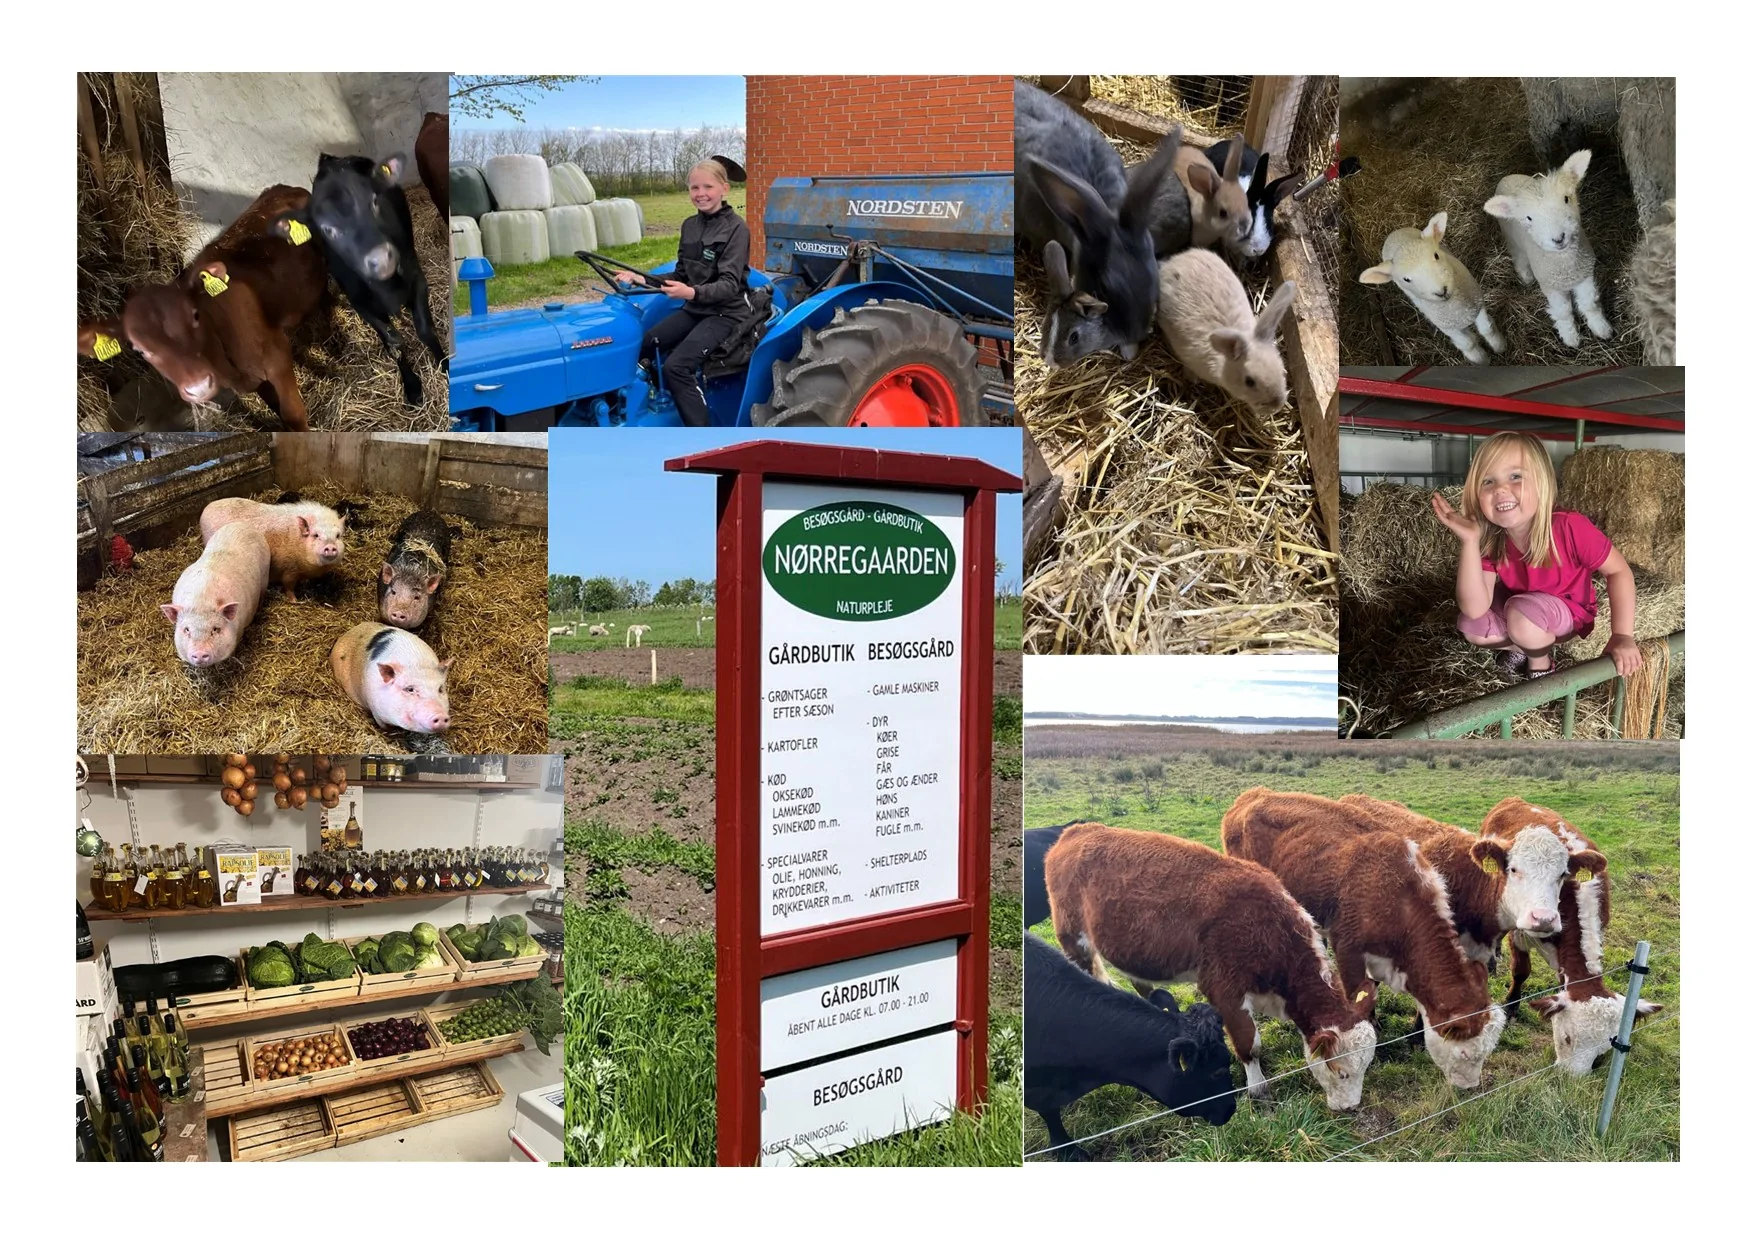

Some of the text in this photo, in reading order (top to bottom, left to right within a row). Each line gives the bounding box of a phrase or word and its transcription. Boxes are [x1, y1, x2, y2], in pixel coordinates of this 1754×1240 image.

[847, 200, 963, 219] NORDSTEN
[794, 242, 849, 256] NORDSTEN
[803, 508, 864, 531] BESØGSGÅRD
[874, 509, 924, 534] GÅRDBUTIK
[775, 544, 948, 575] NØRREGAARDEN
[836, 599, 893, 614] NATURPLEJE
[769, 642, 855, 665] GÅRDBUTIK
[868, 637, 954, 660] BESØGSGÅRD
[768, 688, 828, 703] GRØNTSAGER
[872, 682, 900, 696] GAMLE
[902, 681, 939, 694] MASKINER
[773, 703, 834, 719] EFTER SÆSON
[872, 716, 889, 727] DYR
[767, 737, 818, 753] KARTOFLER
[876, 731, 898, 743] KØER
[876, 746, 899, 758] GRISE
[876, 761, 892, 774] FÅR
[767, 773, 787, 786] KØD
[876, 773, 938, 790] GÆS OG ÆNDER
[772, 787, 813, 802] OKSEKØD
[876, 793, 898, 806] HØNS
[772, 802, 821, 819] LAMMEKØD
[876, 806, 910, 821] KANINER
[772, 818, 841, 836] SVINEKØD m.m.
[876, 822, 924, 837] FUGLE m.m.
[767, 849, 828, 869] SPECIALVARER
[870, 849, 927, 869] SHELTERPLADS
[772, 863, 842, 885] OLIE, HONNING,
[772, 881, 828, 900] KRYDDERIER,
[869, 880, 920, 899] AKTIVITETER
[772, 894, 854, 916] DRIKKEVARER m.m.
[821, 974, 900, 1009] GÅRDBUTIK
[787, 1019, 815, 1037] ÅBENT
[817, 1014, 837, 1030] ALLE
[839, 1008, 862, 1024] DAGE
[864, 1004, 876, 1018] KL.
[878, 999, 901, 1014] 07.00
[908, 992, 930, 1007] 21.00
[813, 1066, 903, 1107] BESØGSGÅRD
[793, 1121, 848, 1146] ÅBNINGSDAG:
